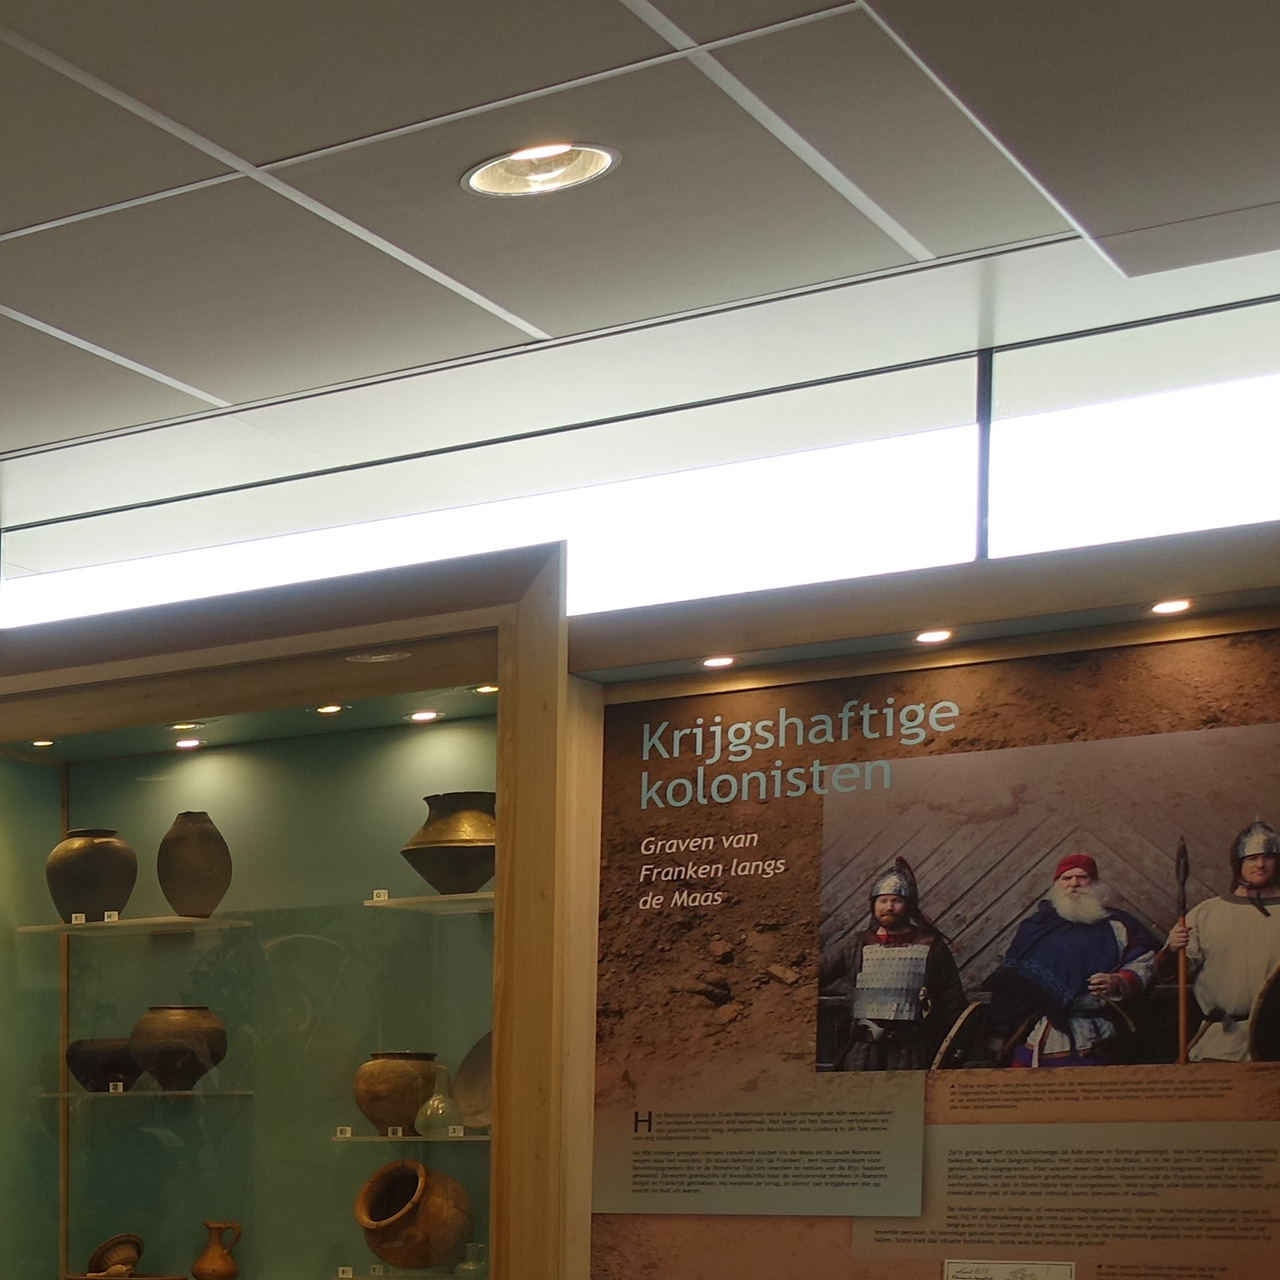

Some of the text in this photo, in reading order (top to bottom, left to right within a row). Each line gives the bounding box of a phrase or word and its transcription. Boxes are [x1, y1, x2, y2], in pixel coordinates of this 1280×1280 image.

[642, 698, 960, 765] Krijgshaftige
[640, 758, 892, 810] kolonisten
[640, 832, 758, 856] Graven van
[639, 855, 786, 883] Franken langs
[638, 888, 723, 910] de Maas
